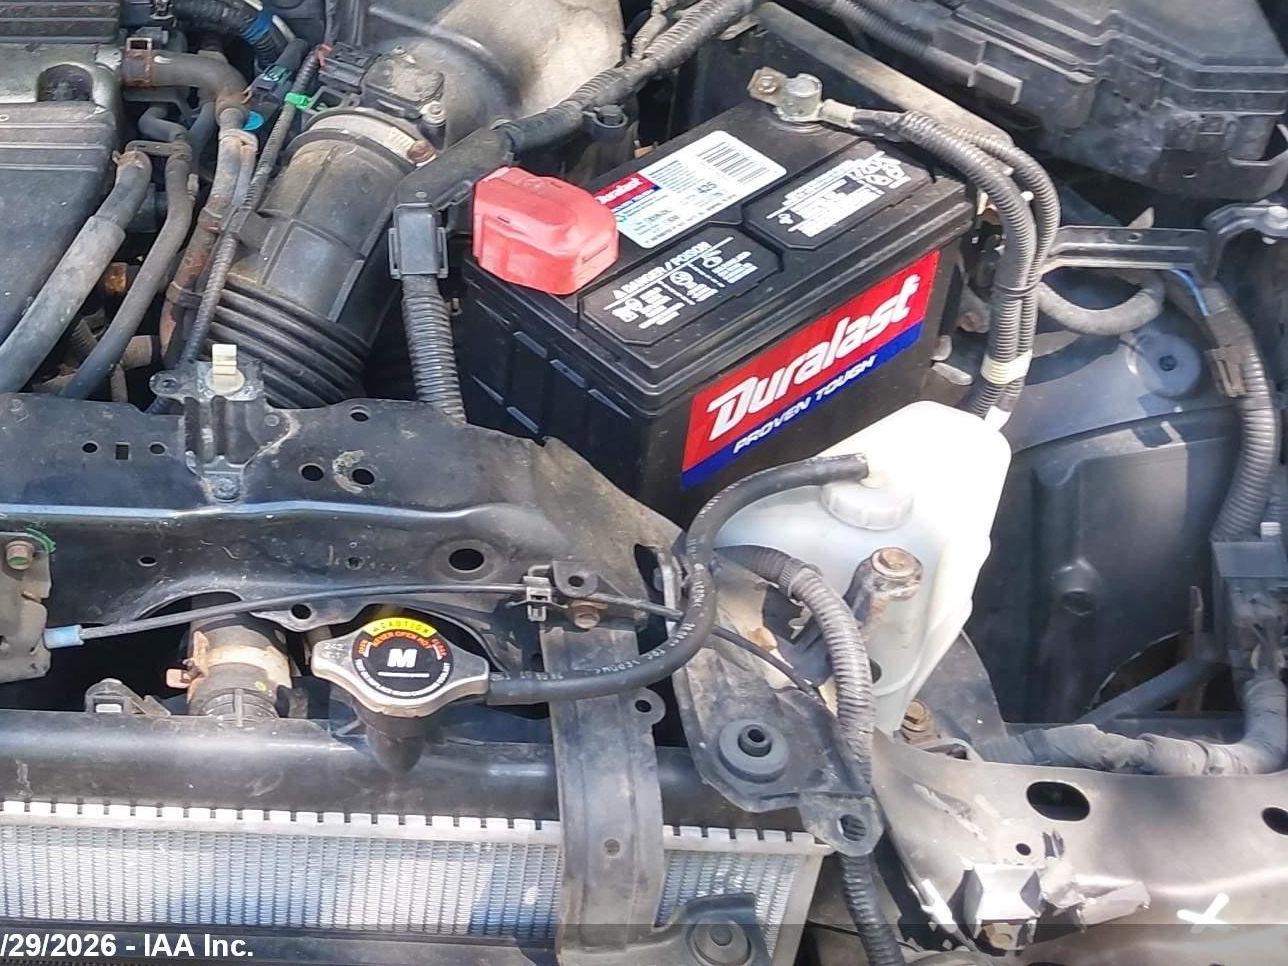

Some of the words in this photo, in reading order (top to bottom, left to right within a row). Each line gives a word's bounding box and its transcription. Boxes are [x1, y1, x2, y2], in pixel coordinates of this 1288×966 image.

[706, 274, 921, 442] Duralast
[732, 396, 812, 454] PROVEN
[815, 354, 878, 401] TOUGH
[387, 648, 418, 668] M
